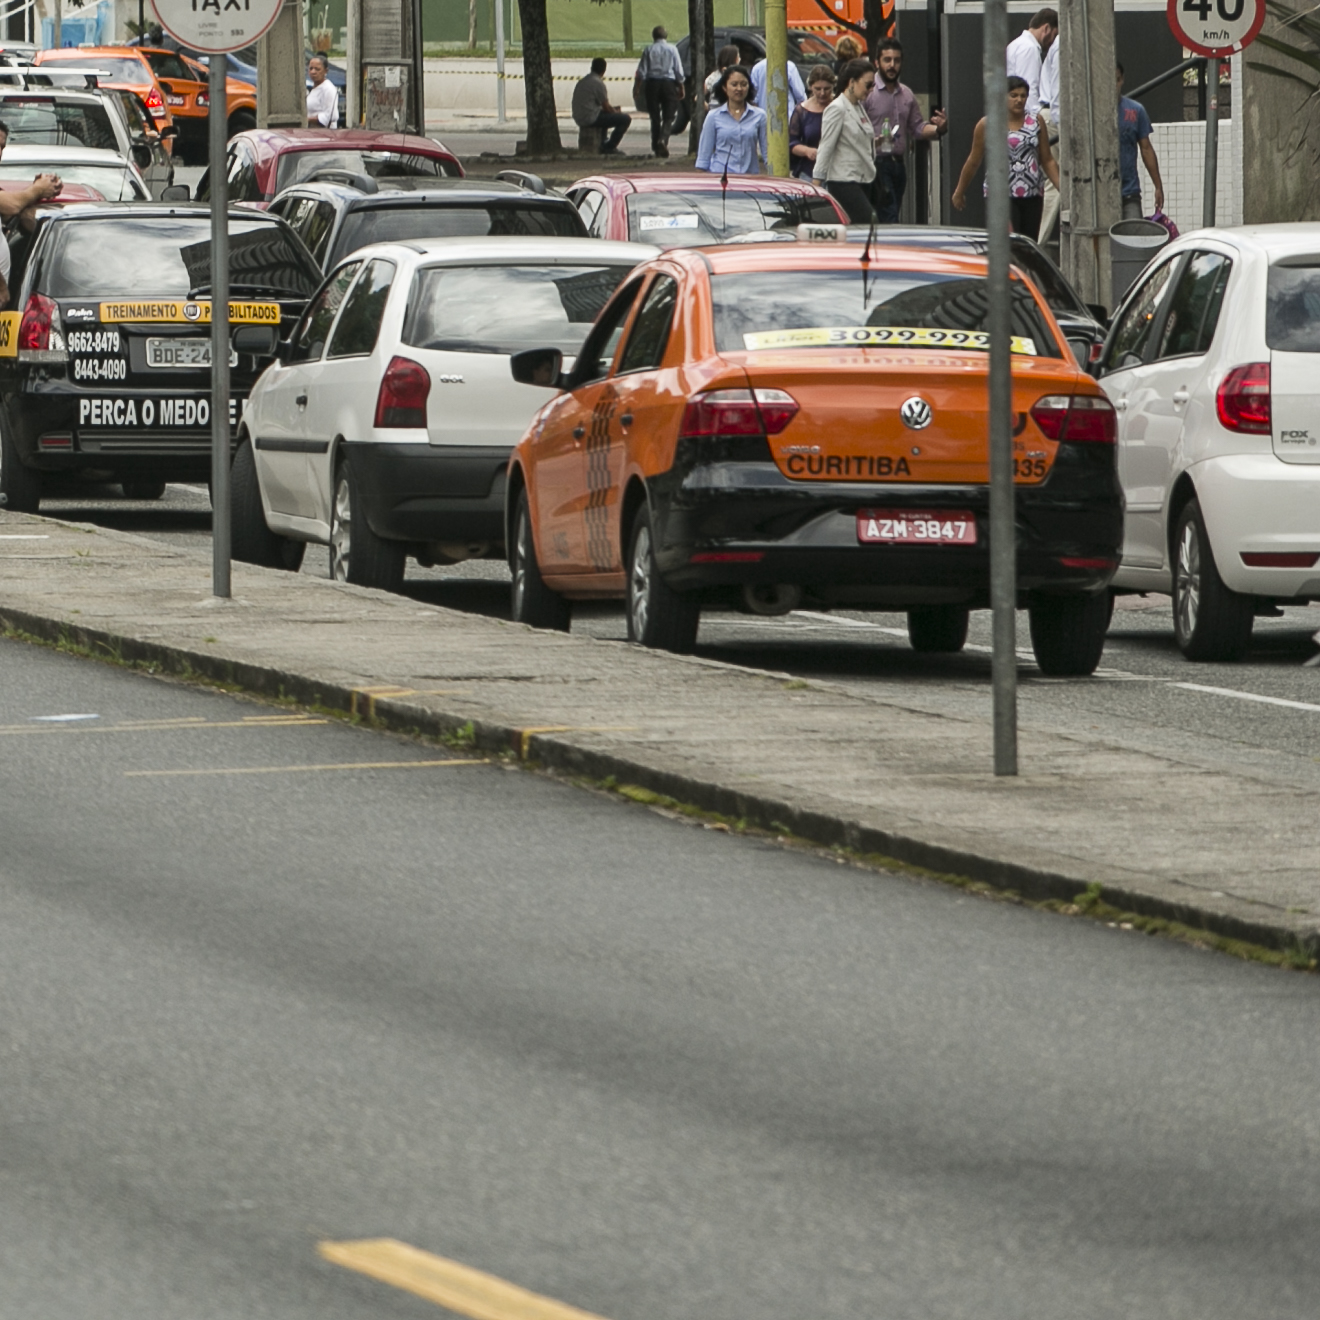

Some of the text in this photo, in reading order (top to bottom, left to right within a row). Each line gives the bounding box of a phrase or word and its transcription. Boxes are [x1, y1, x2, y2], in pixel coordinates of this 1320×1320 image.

[1203, 30, 1229, 41] km/h
[807, 228, 837, 241] TAXI
[106, 304, 177, 319] TREINAMENTO
[228, 305, 277, 320] BILITADOS
[68, 332, 120, 353] 9662-8479
[829, 329, 1013, 348] 3099-999
[74, 358, 126, 380] 8443-4090
[79, 399, 138, 425] PERCA
[142, 399, 155, 425] O
[160, 399, 210, 425] MEDO
[787, 455, 911, 476] CURITIBA
